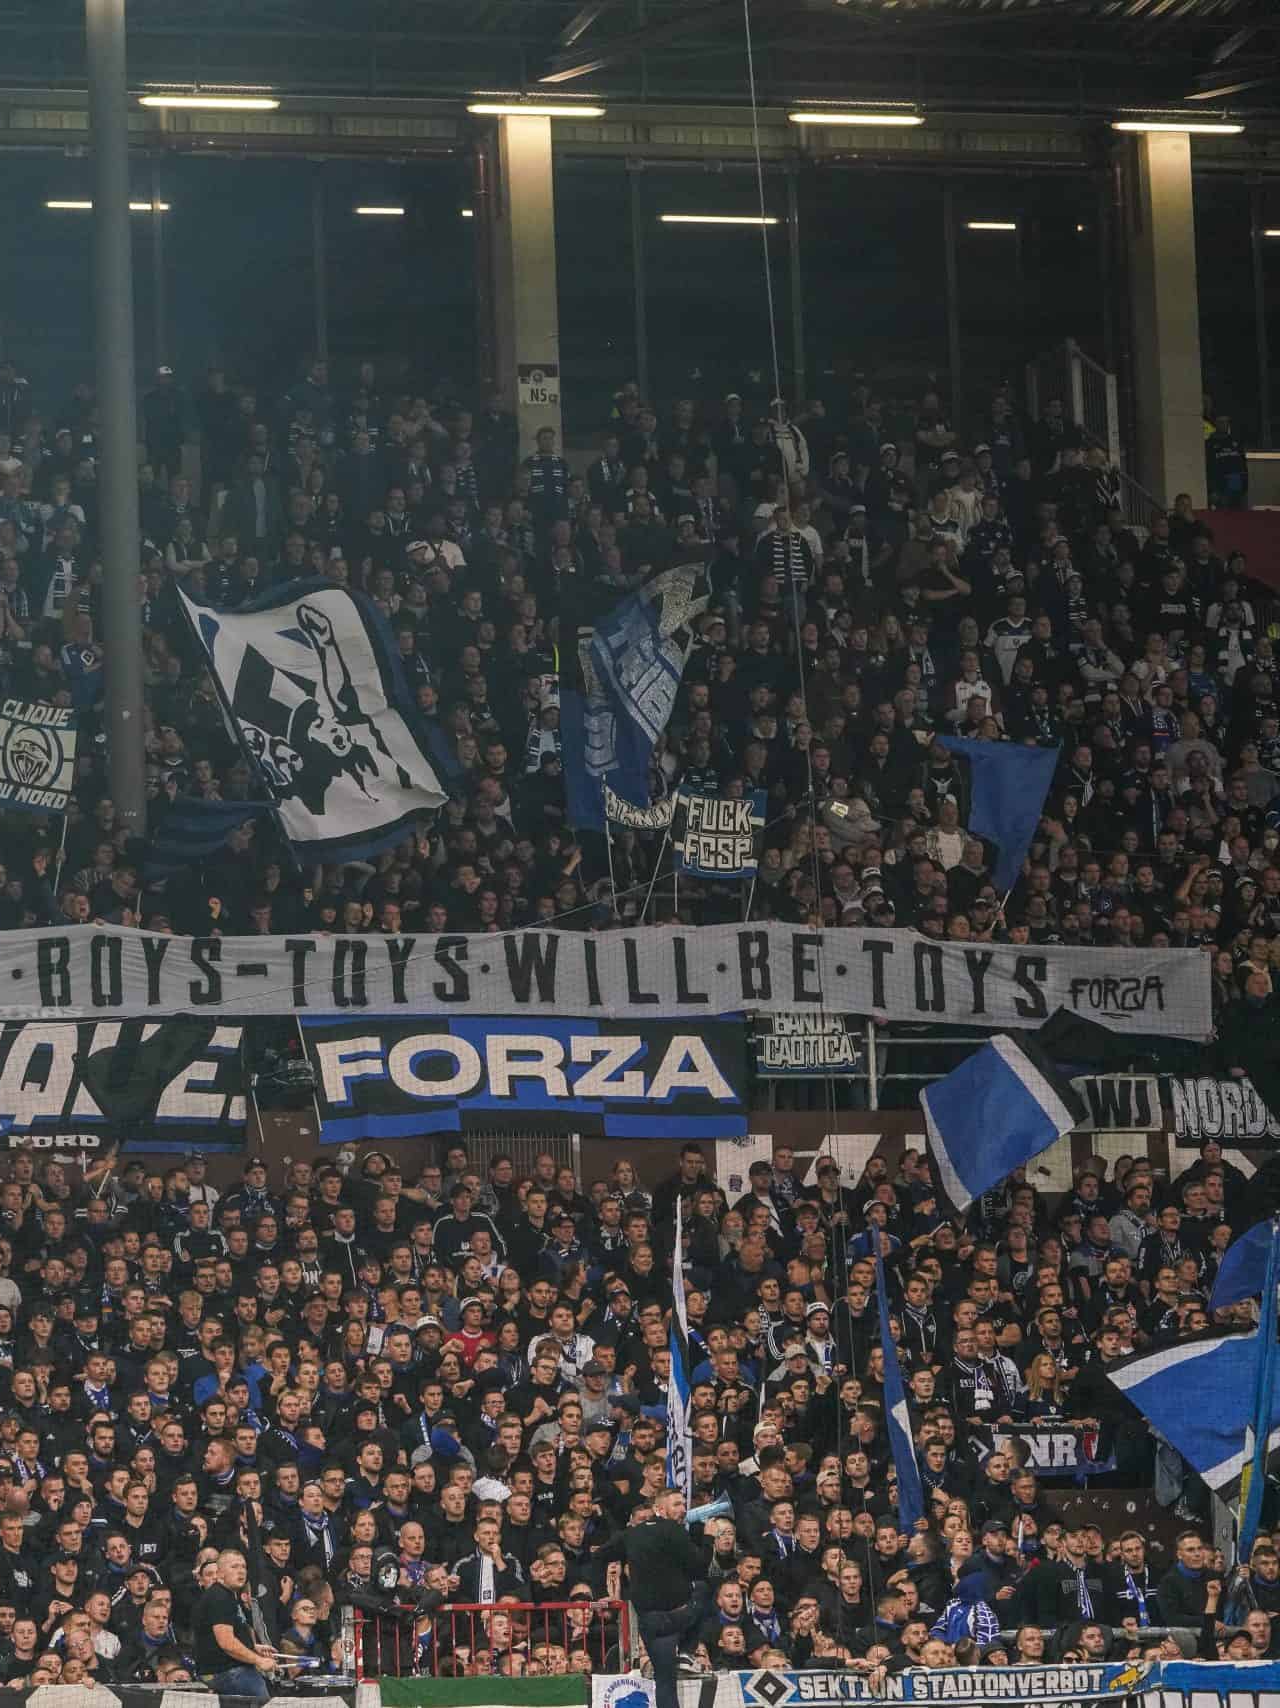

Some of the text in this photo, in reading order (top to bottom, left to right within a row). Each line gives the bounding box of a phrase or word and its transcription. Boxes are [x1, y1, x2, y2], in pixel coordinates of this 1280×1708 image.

[1, 698, 74, 728] CLIQUE
[14, 787, 69, 809] NORD
[688, 796, 753, 835] FUCK
[504, 933, 708, 1006] WILL
[738, 931, 825, 1004] BE
[862, 939, 1049, 1019] TOYS
[1070, 975, 1165, 1011] FORZA
[316, 1033, 738, 1103] FORZA
[1172, 1076, 1280, 1138] NORD
[8, 1134, 100, 1148] NORD
[912, 1668, 1105, 1701] STADIONVERBOT
